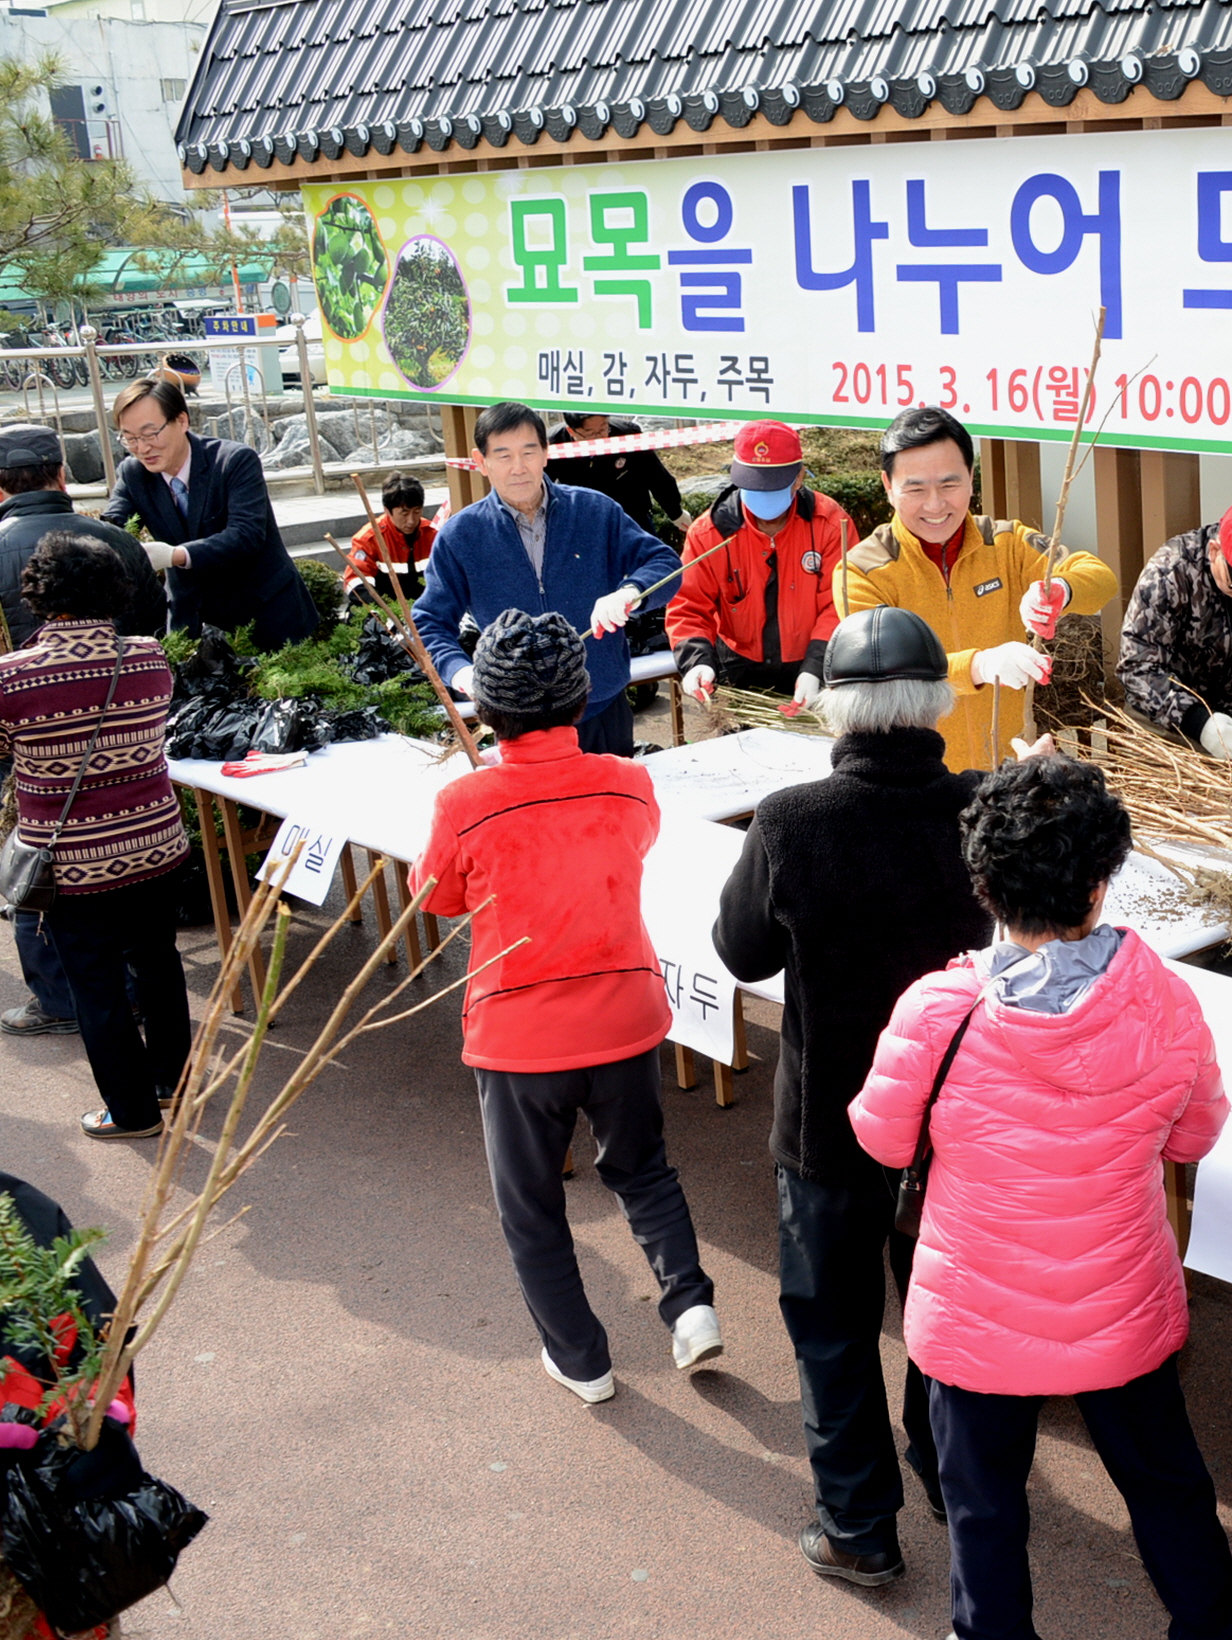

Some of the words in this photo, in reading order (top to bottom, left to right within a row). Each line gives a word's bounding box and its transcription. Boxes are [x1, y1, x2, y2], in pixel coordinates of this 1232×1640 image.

[508, 181, 753, 333] 묘목을
[793, 169, 1123, 340] 나누어
[539, 351, 593, 397] 매실,
[604, 353, 635, 399] 감,
[646, 354, 706, 402] 자두,
[718, 355, 774, 404] 주목
[986, 365, 1097, 424] 16(월)
[1115, 374, 1231, 426] 10:00
[281, 824, 333, 874] 매실
[659, 957, 719, 1021] 자두
